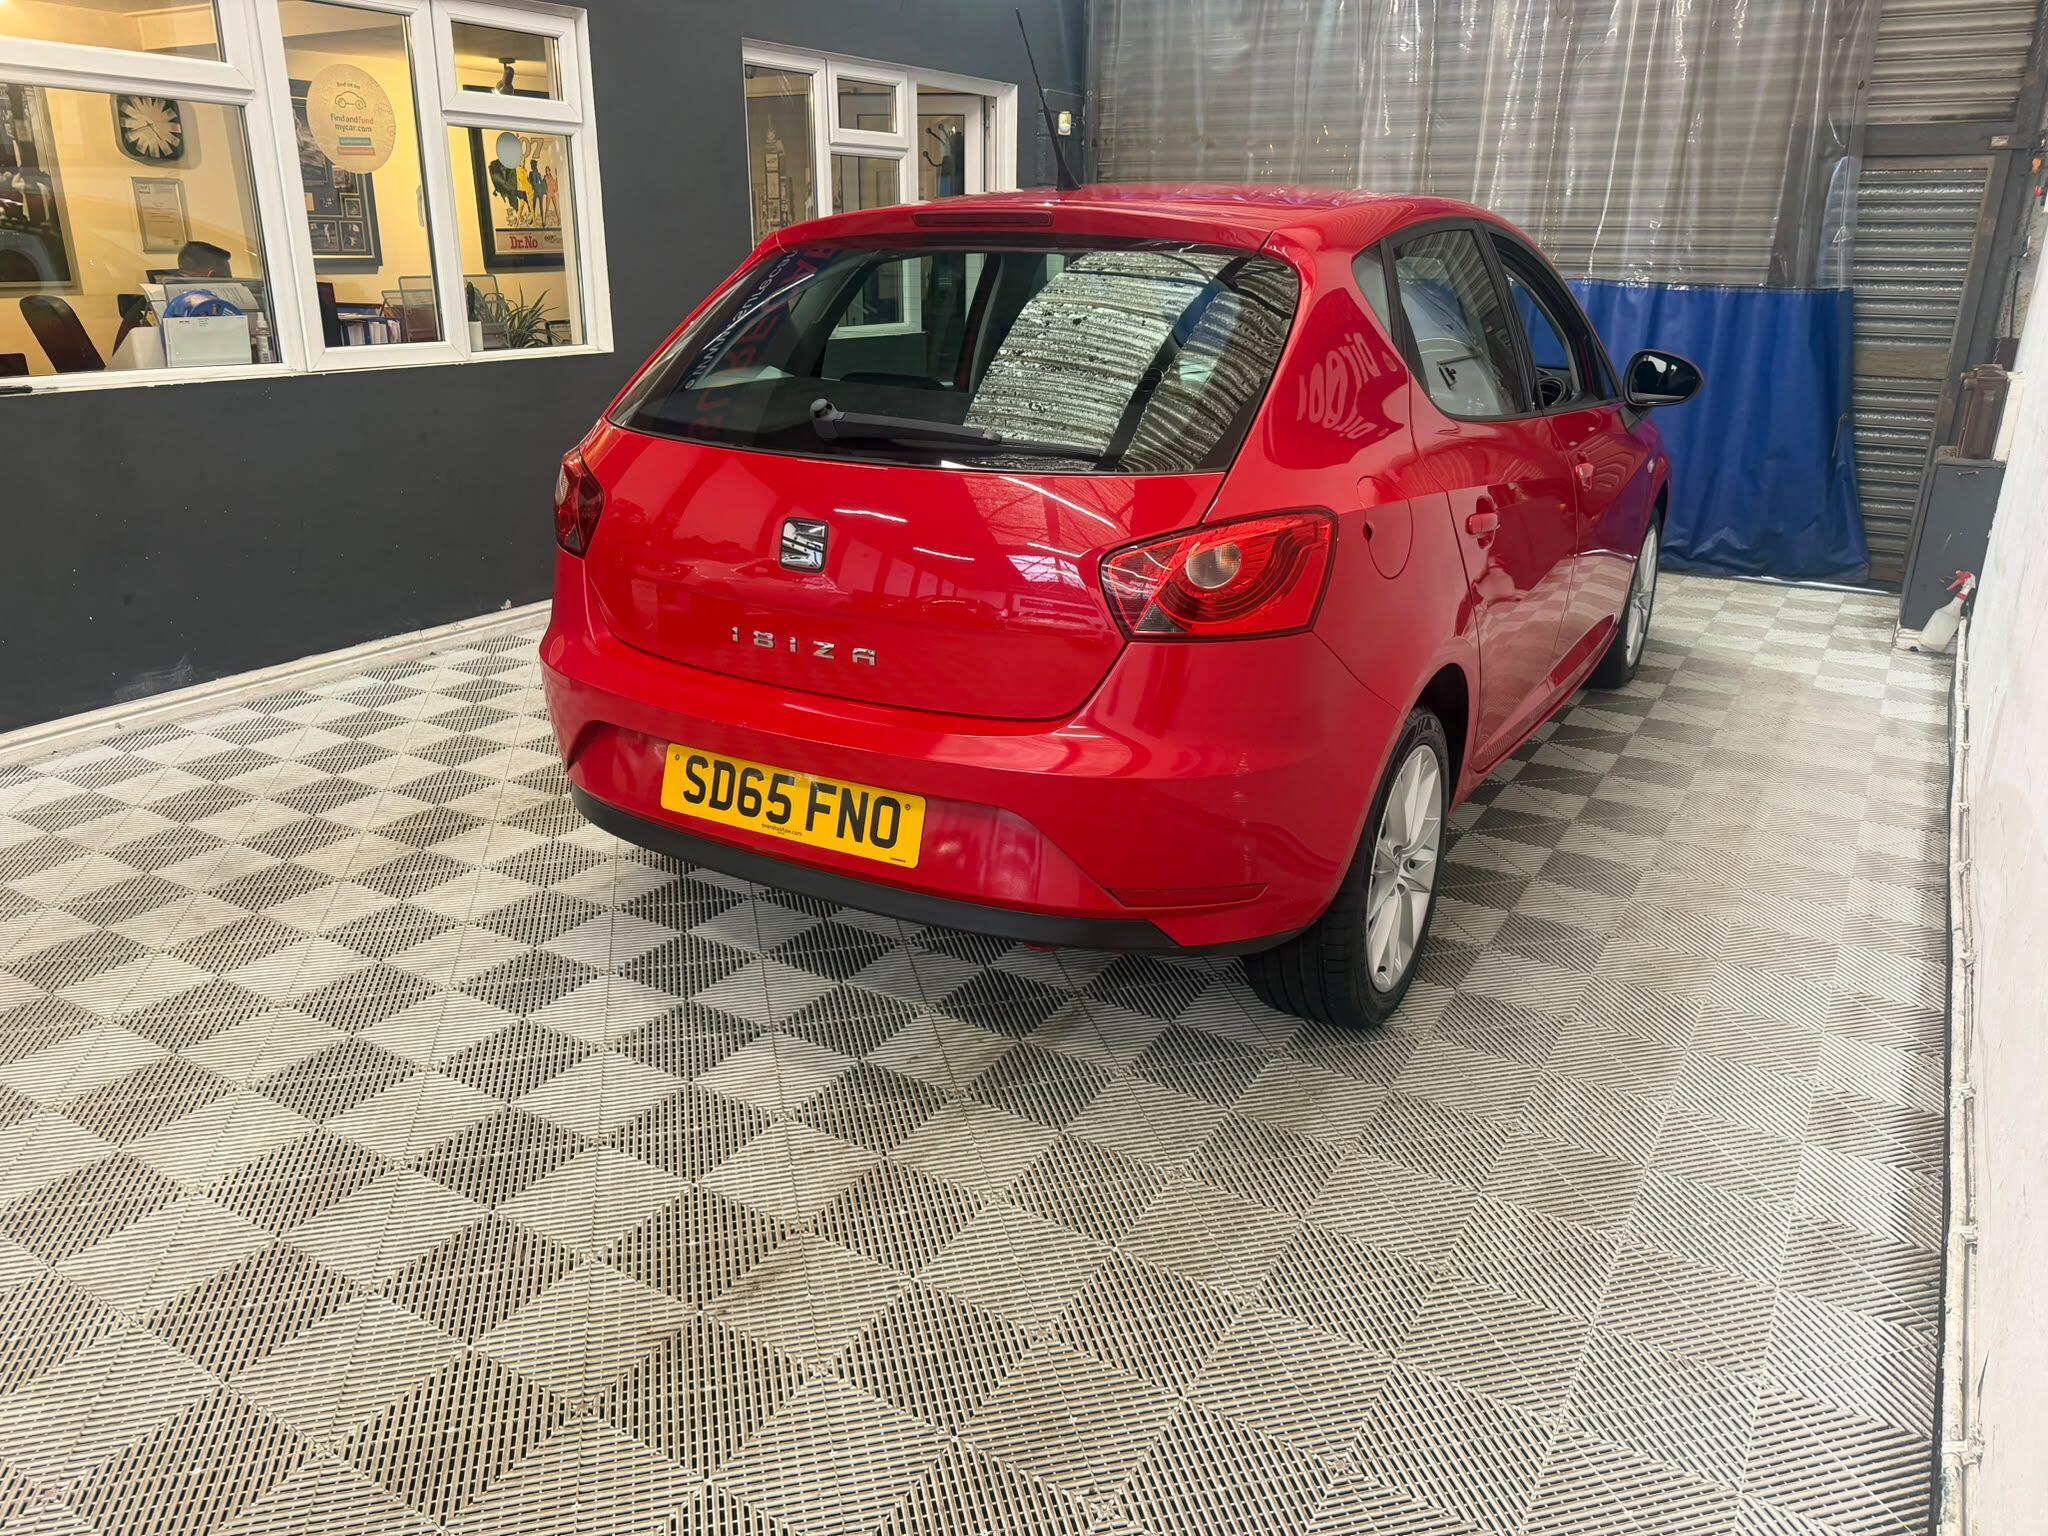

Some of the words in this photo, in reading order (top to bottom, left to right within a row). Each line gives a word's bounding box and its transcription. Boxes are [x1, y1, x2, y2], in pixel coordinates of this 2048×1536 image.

[334, 123, 373, 133] mycar.com
[731, 625, 877, 667] IBIZA
[682, 753, 796, 826] SD65
[804, 780, 902, 849] FNO
